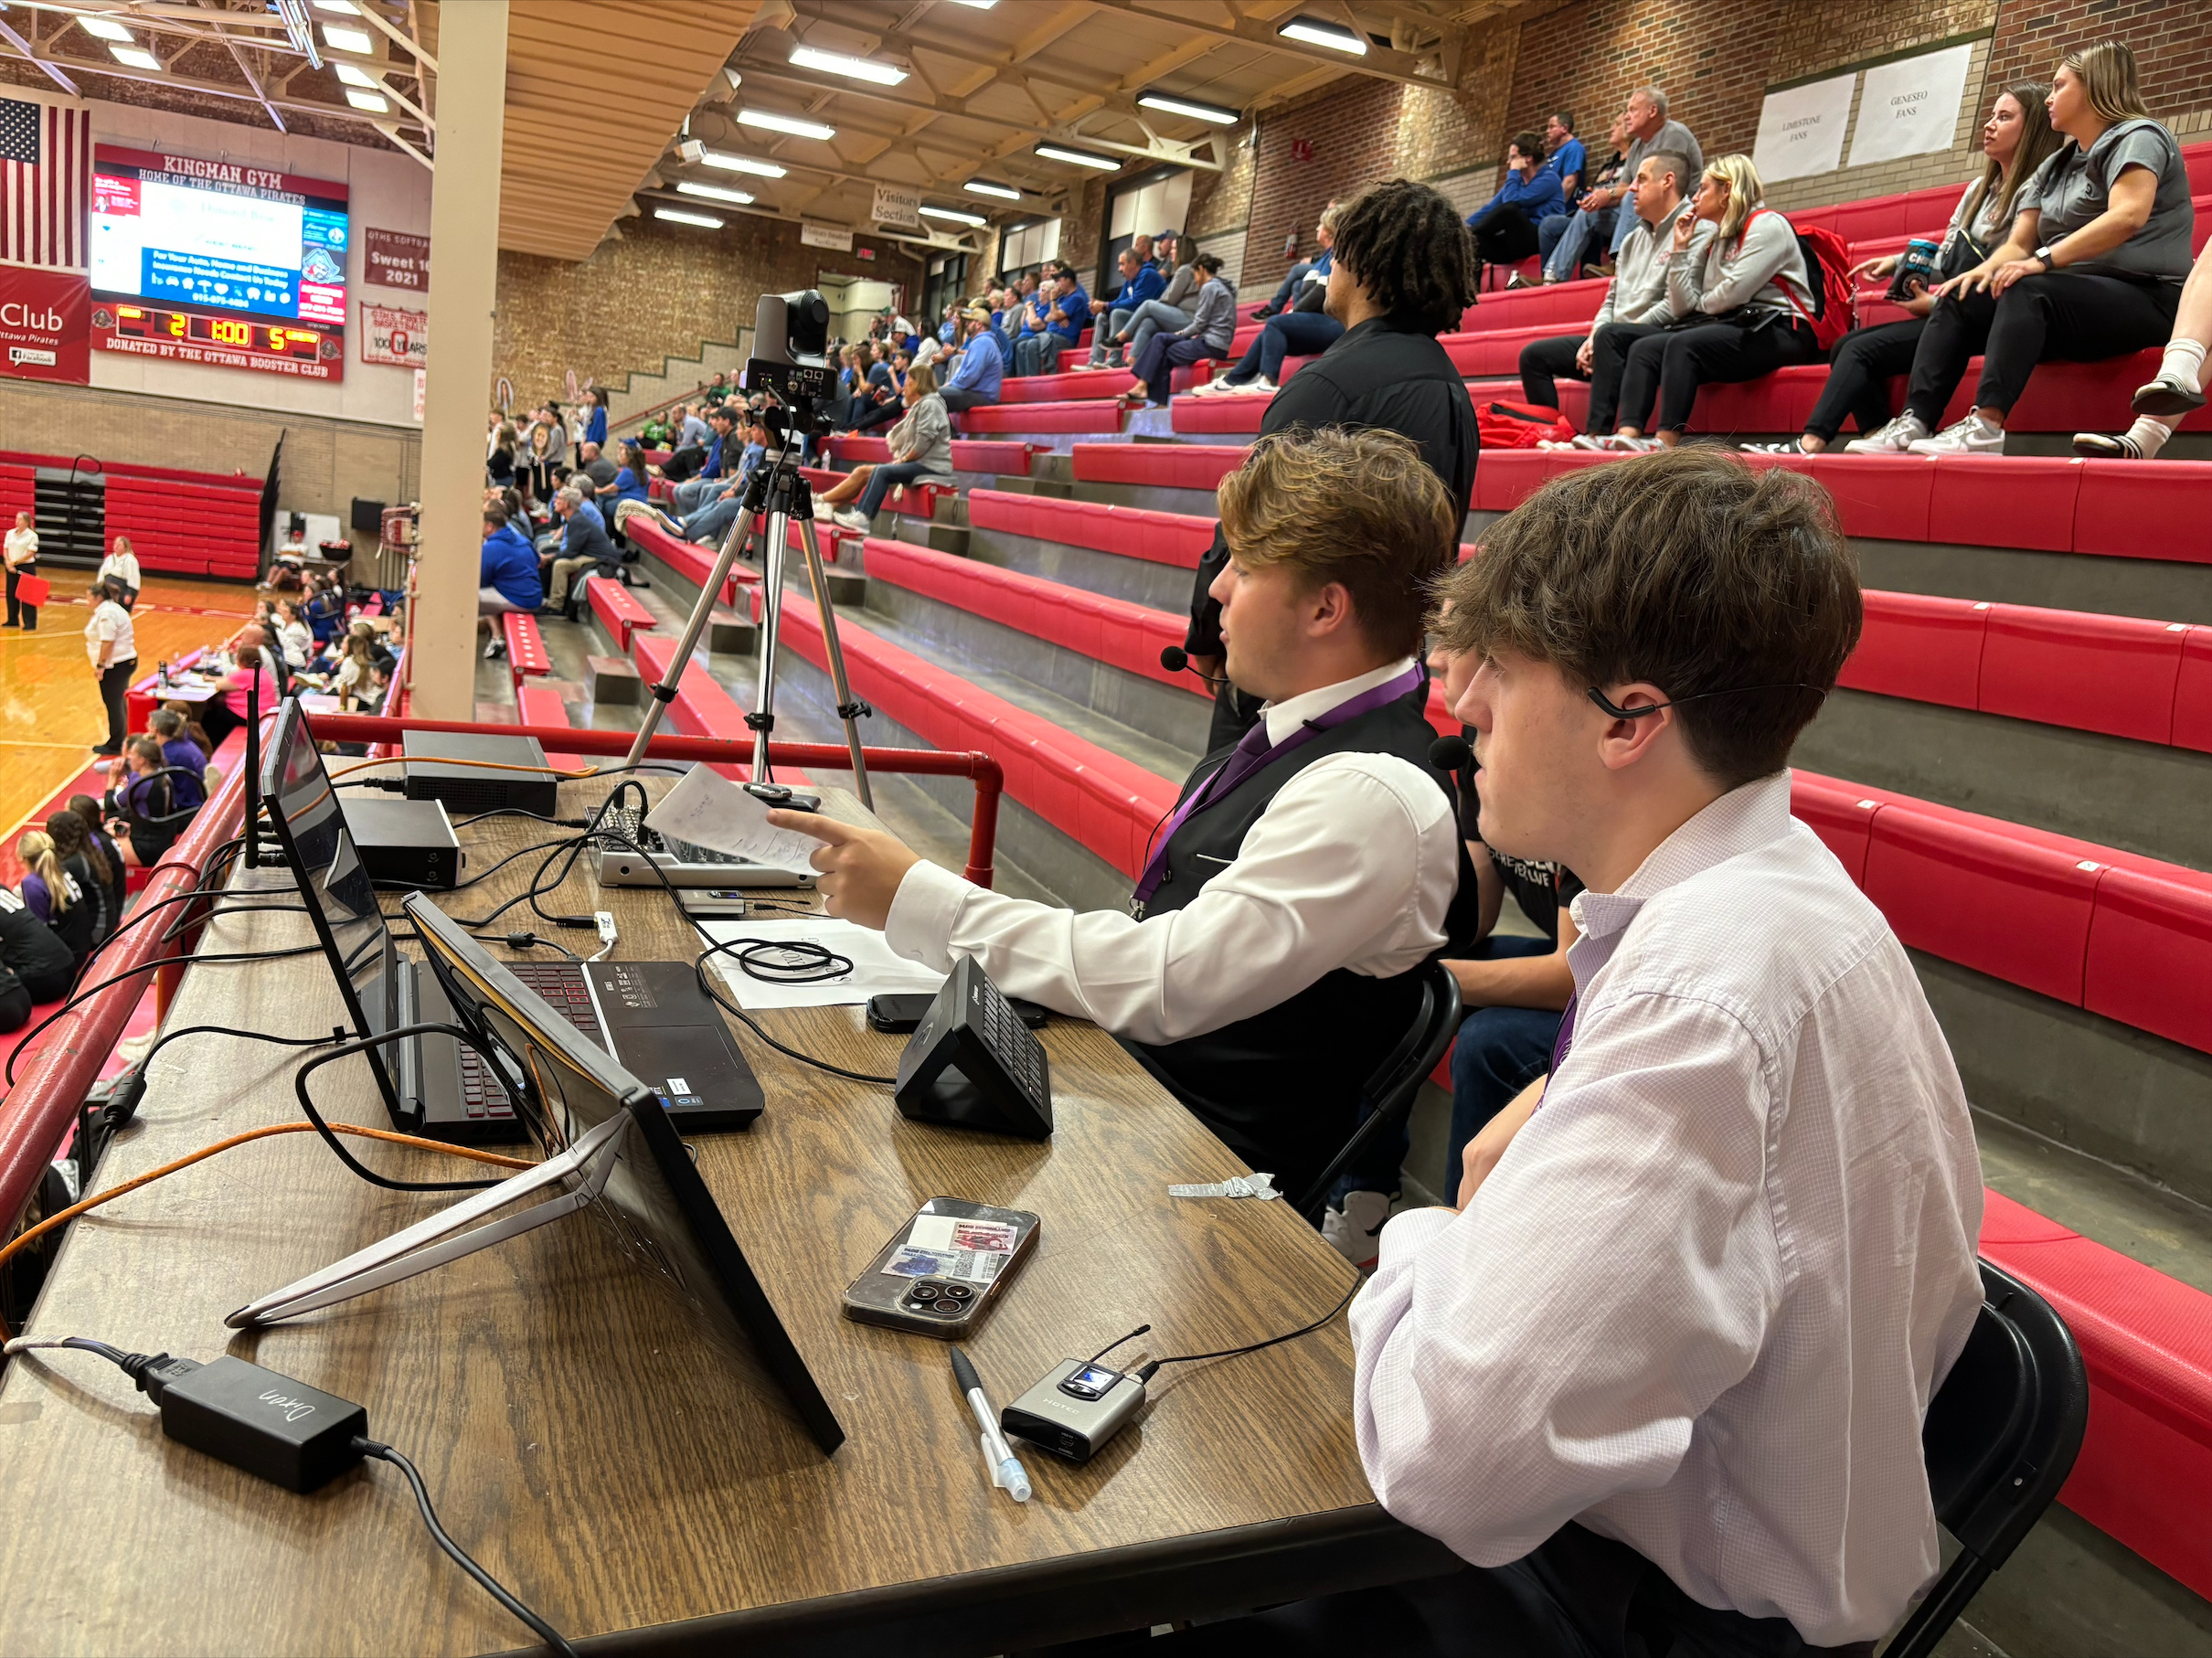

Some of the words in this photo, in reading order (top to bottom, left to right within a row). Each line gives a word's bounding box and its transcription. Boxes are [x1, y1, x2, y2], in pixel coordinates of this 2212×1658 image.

[1889, 90, 1929, 106] GENESEO
[1895, 106, 1918, 119] FANS
[1782, 114, 1822, 132] LIMESTONE
[1789, 131, 1808, 143] FANS
[164, 155, 242, 184] KINGMAN
[247, 168, 282, 190] GYM
[139, 168, 169, 184] HOME
[172, 177, 186, 186] OF
[189, 177, 212, 190] THE
[215, 181, 258, 197] OTTAWA
[261, 187, 306, 206] PIRATES
[877, 188, 919, 207] Visitors
[876, 206, 916, 223] Section
[367, 230, 392, 243] OTHS
[394, 235, 429, 248] SOFTBA
[371, 251, 414, 270] Sweet
[386, 269, 418, 286] 2021
[0, 303, 63, 332] Club
[170, 313, 186, 336] 2
[0, 331, 27, 342] ttawa
[28, 334, 59, 345] Pirates
[211, 319, 249, 345] 1:00
[269, 327, 285, 350] 5
[374, 336, 391, 349] 100
[396, 339, 427, 356] YEARS
[106, 337, 157, 355] DONATED
[160, 344, 176, 357] BY
[178, 346, 202, 360] THE
[204, 352, 248, 367] OTTAWA
[250, 356, 299, 374] BOOSTER
[300, 364, 328, 378] CLUB
[63, 871, 83, 903] 15
[259, 1388, 316, 1422] Dixon
[1043, 1398, 1080, 1416] HOTEC
